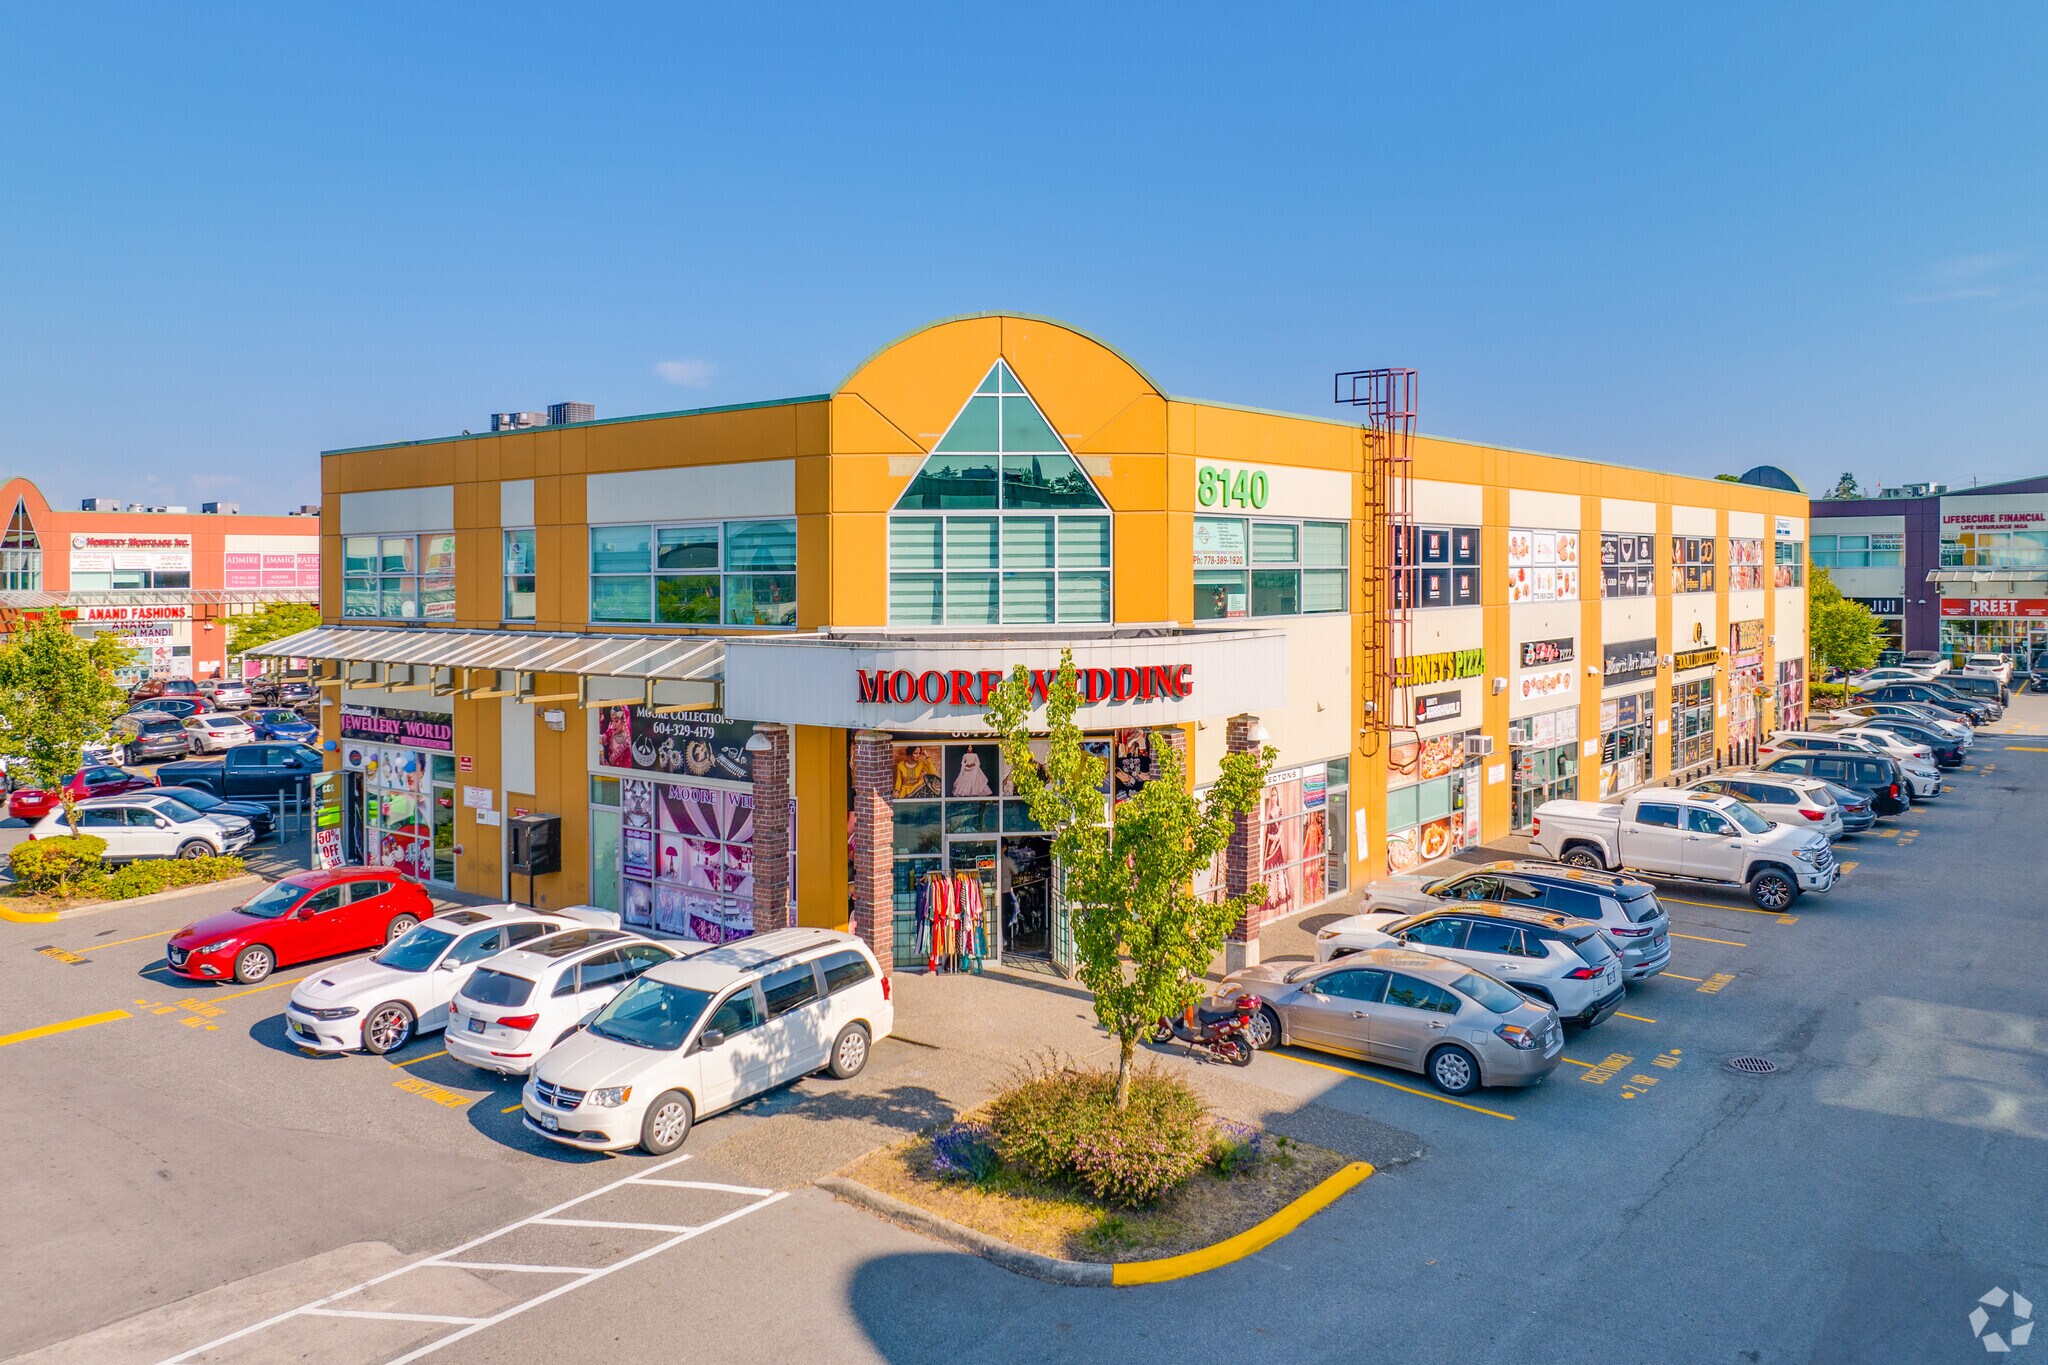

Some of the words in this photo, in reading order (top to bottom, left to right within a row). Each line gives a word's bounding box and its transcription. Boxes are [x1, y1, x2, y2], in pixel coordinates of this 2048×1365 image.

[1198, 465, 1269, 509] 8140
[1943, 514, 1995, 524] LIFESECURE
[1999, 513, 2046, 522] FINANCIAL
[227, 556, 258, 564] ADMIRE
[1204, 556, 1243, 565] 778-389-1920
[1970, 600, 2018, 612] PREET
[88, 609, 128, 620] ANAND
[131, 607, 186, 619] FASHIONS
[140, 628, 171, 637] MANDI
[1455, 648, 1486, 679] PIZZA
[856, 668, 1003, 705] MOORE
[341, 714, 400, 734] JEWELLERY
[405, 722, 451, 740] WORLD
[653, 721, 715, 739] 604-329-4179
[668, 784, 717, 804] MOORE
[318, 830, 339, 845] 50%
[322, 844, 339, 858] OFF
[327, 860, 342, 869] SALE
[391, 1078, 472, 1109] CUSTOMER
